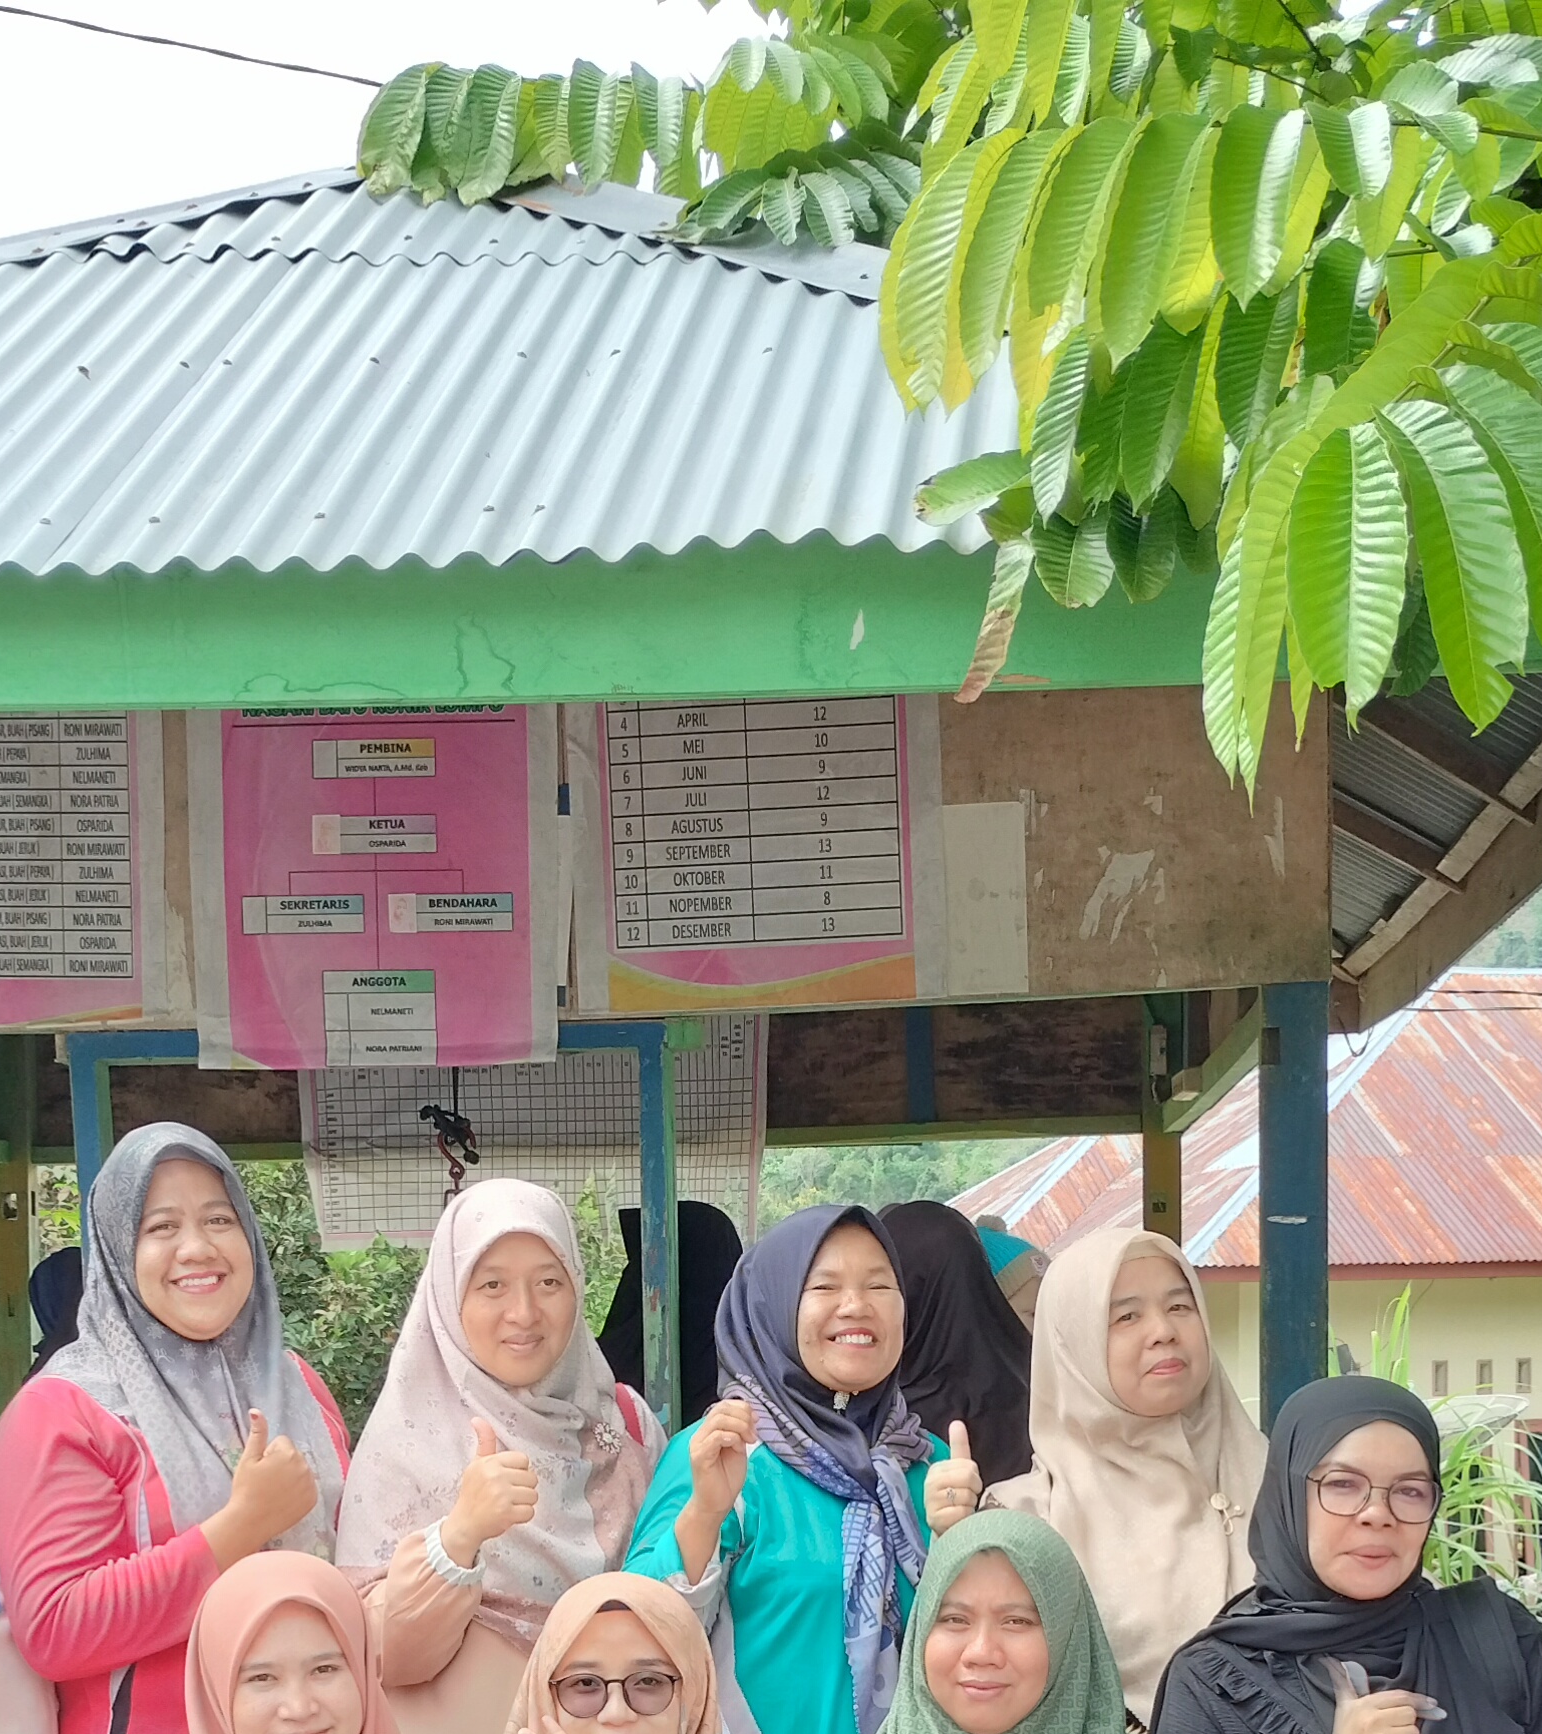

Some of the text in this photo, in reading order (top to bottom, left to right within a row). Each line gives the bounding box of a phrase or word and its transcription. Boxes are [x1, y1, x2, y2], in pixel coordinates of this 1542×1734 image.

[676, 712, 709, 729] APRIL
[813, 705, 828, 722] 12
[64, 723, 123, 737] RONI MIRAWATI
[620, 717, 628, 732] 4
[683, 738, 705, 755] MEI
[814, 732, 829, 748] 10
[76, 747, 112, 761] ZULHIMA
[359, 743, 412, 754] PEMBINA
[621, 743, 629, 759] 5
[681, 765, 707, 781] JUNI
[818, 759, 826, 774] 9
[73, 771, 117, 784] NELMANETI
[623, 769, 631, 785] 6
[70, 794, 120, 808] NORA PATRIA
[684, 791, 707, 808] JULI
[816, 785, 831, 801] 12
[623, 796, 632, 811] 7
[77, 819, 114, 832] OSPARIDA
[368, 819, 405, 830] KETUA
[671, 817, 724, 835] AGUSTUS
[820, 811, 828, 827] 9
[625, 822, 633, 838] 8
[66, 843, 126, 856] RONI MIRAWATI
[368, 839, 407, 848] OSPARIDA
[818, 837, 832, 854] 13
[626, 848, 634, 864] 9
[665, 843, 731, 861] SEPTEMBER
[78, 866, 115, 879] ZULHIMA
[673, 870, 726, 887] OKTOBER
[819, 864, 834, 880] 11
[624, 874, 639, 890] 10
[75, 889, 119, 903] NELMANETI
[428, 898, 498, 909] BENDAHARA
[823, 890, 831, 906] 8
[279, 899, 350, 910] SEKRETARIS
[625, 900, 640, 916] 11
[669, 896, 733, 913] NOPEMBER
[73, 913, 123, 926] NORA PATRIA
[434, 918, 494, 927] RONI MIRAWATI
[821, 916, 836, 932] 13
[626, 926, 641, 942] 12
[672, 922, 732, 940] DESEMBER
[79, 936, 117, 950] OSPARIDA
[69, 959, 128, 973] RONI MIRAWATI
[352, 976, 407, 987] ANGGOTA
[370, 1007, 414, 1016] NELMANETI
[365, 1045, 423, 1053] NORA PATRIANI
